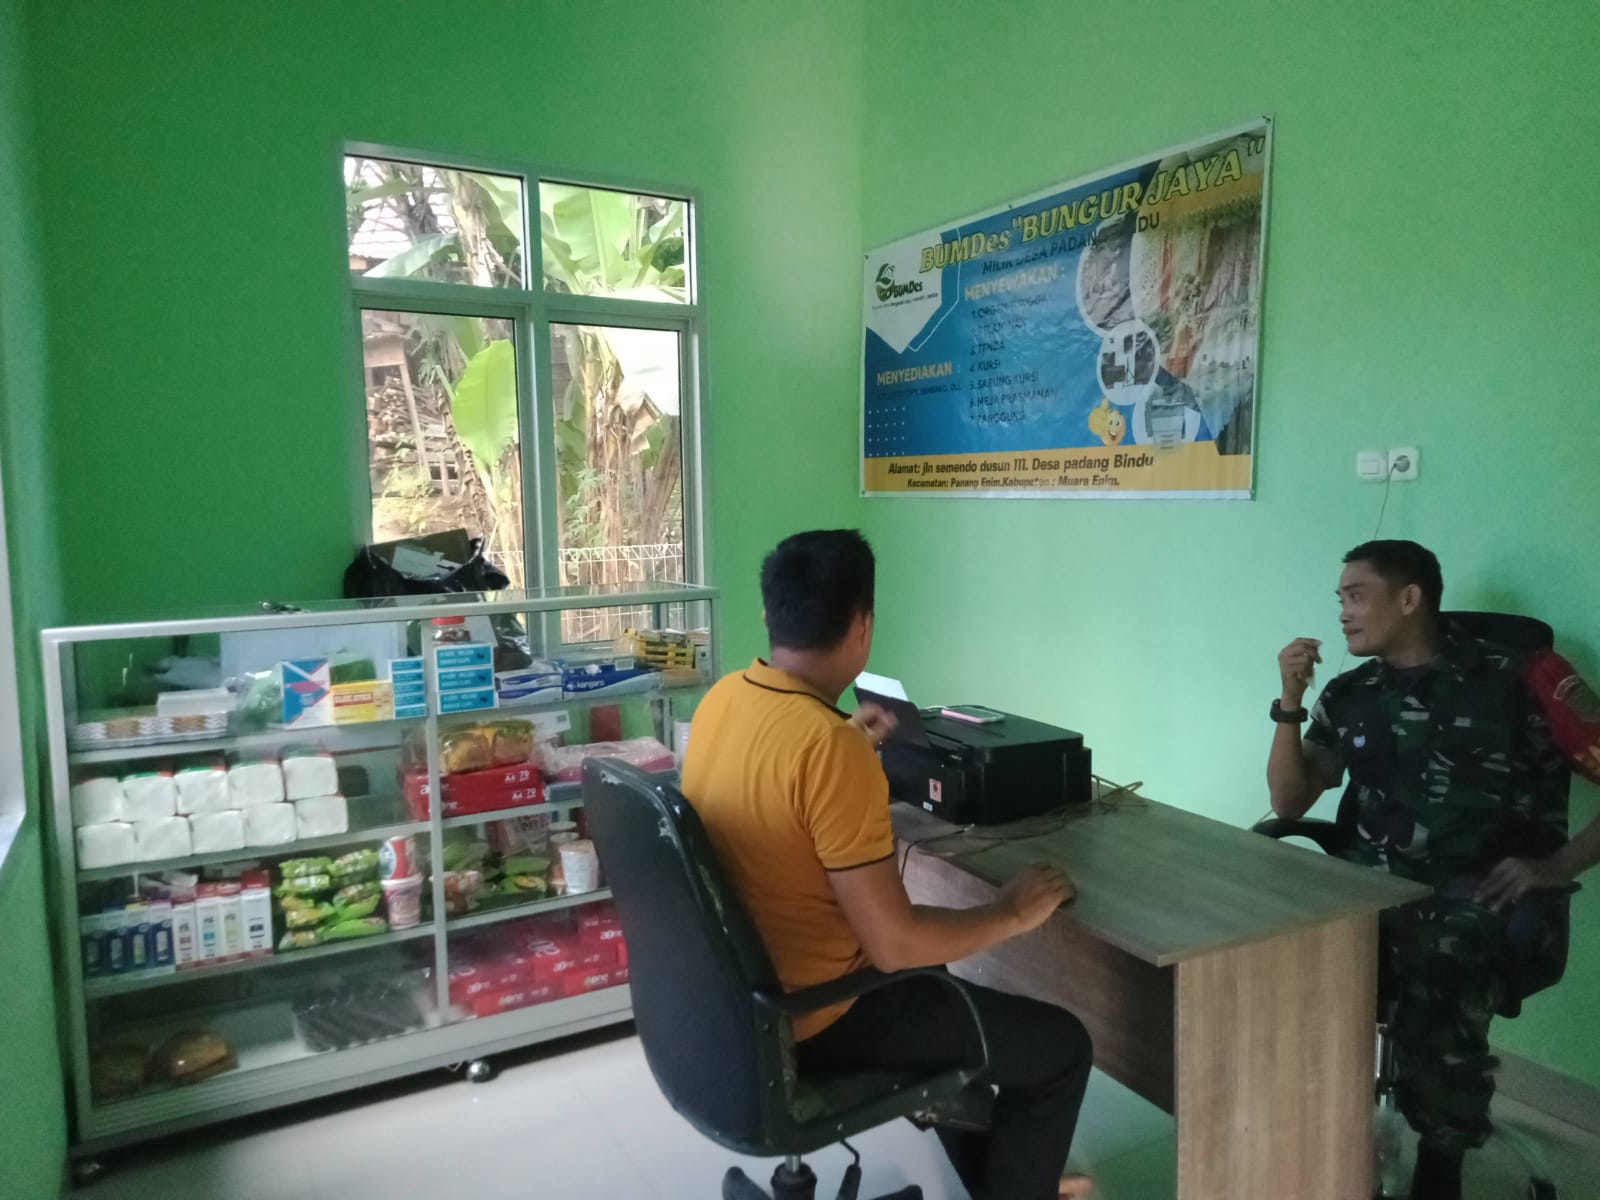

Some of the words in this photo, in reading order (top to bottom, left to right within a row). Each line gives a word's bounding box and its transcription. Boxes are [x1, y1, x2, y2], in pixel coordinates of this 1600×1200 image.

[919, 231, 1012, 274] BUMDes
[1050, 231, 1097, 257] PADAN
[876, 361, 952, 386] MENYEDIAKAN
[888, 462, 921, 475] Alamat:
[936, 460, 977, 473] semendo
[980, 460, 1010, 472] dusun
[1032, 457, 1060, 471] Desa
[1063, 456, 1109, 473] padang
[1114, 453, 1154, 469] Bindu
[1058, 475, 1090, 487] Muara
